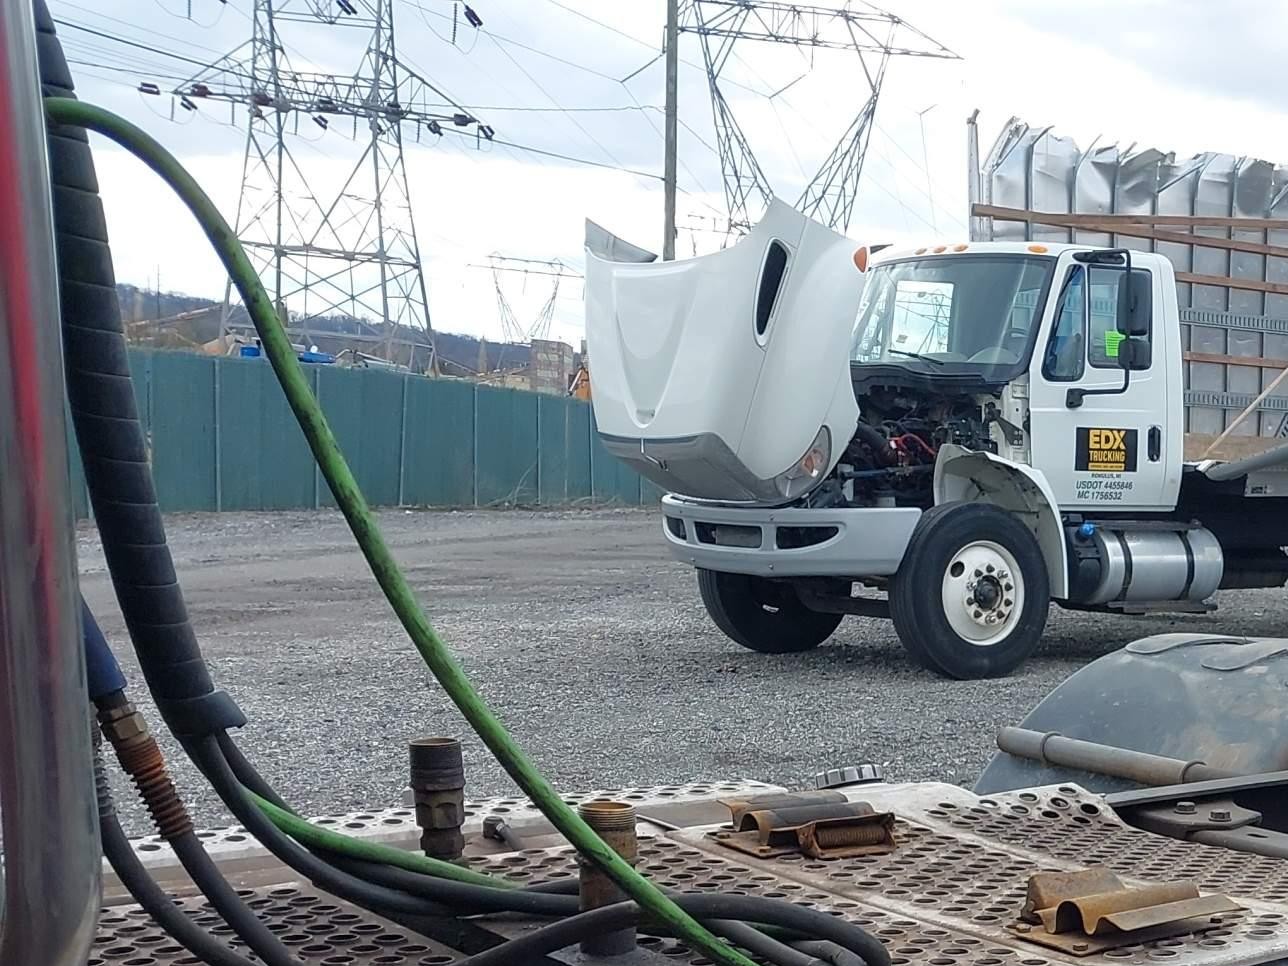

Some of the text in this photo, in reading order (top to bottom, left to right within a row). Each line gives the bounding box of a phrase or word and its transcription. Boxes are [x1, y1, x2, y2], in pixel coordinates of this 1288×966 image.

[1089, 429, 1126, 449] EDX
[1089, 450, 1126, 462] TRUCKING
[1076, 480, 1103, 490] USDOT
[1077, 490, 1090, 499] MC
